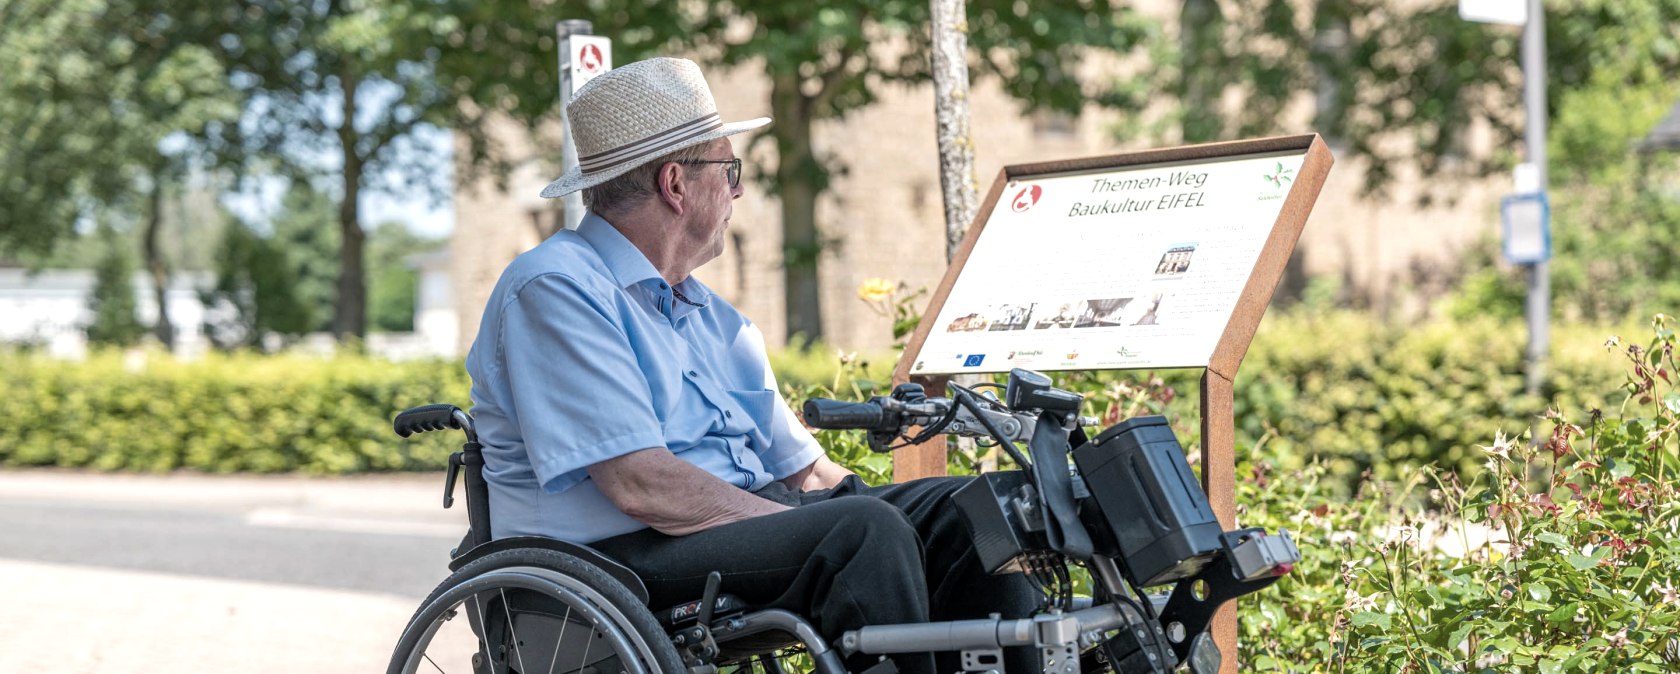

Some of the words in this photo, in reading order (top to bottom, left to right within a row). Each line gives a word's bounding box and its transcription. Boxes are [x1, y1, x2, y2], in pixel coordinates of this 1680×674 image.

[1091, 170, 1209, 193] Themen-Weg
[1068, 197, 1154, 217] Baukultur
[1156, 191, 1205, 210] EIFEL
